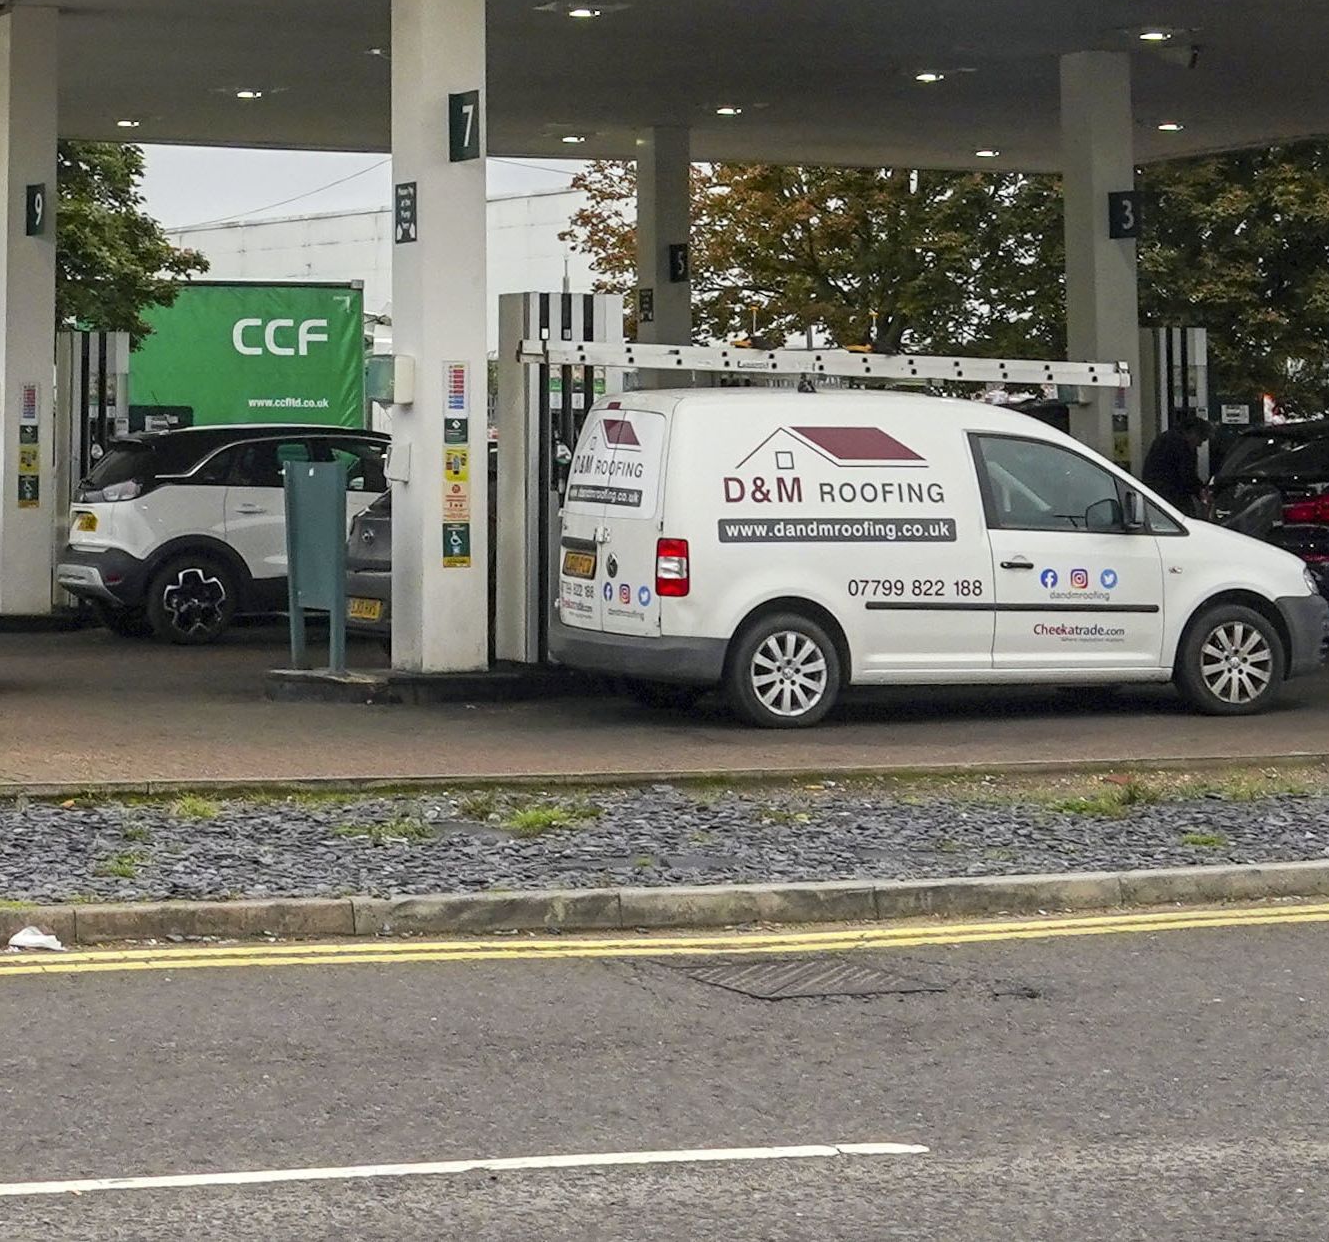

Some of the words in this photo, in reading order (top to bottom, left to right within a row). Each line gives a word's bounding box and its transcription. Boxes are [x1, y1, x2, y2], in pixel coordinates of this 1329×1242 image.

[462, 104, 474, 148] 7
[35, 193, 42, 226] 9
[1122, 199, 1134, 230] 3
[678, 251, 685, 275] 5
[232, 318, 328, 356] CCF
[248, 398, 329, 408] www.ccfltd.co.uk
[595, 459, 644, 478] ROOFING
[724, 477, 803, 503] D&M
[819, 482, 945, 503] ROOFING
[725, 521, 950, 540] www.dandmroofing.co.uk
[848, 579, 904, 597] 07799
[911, 579, 945, 597] 822
[954, 579, 983, 597] 188
[1050, 590, 1110, 602] dandmroofing
[1033, 623, 1125, 636] Checkatrade.com
